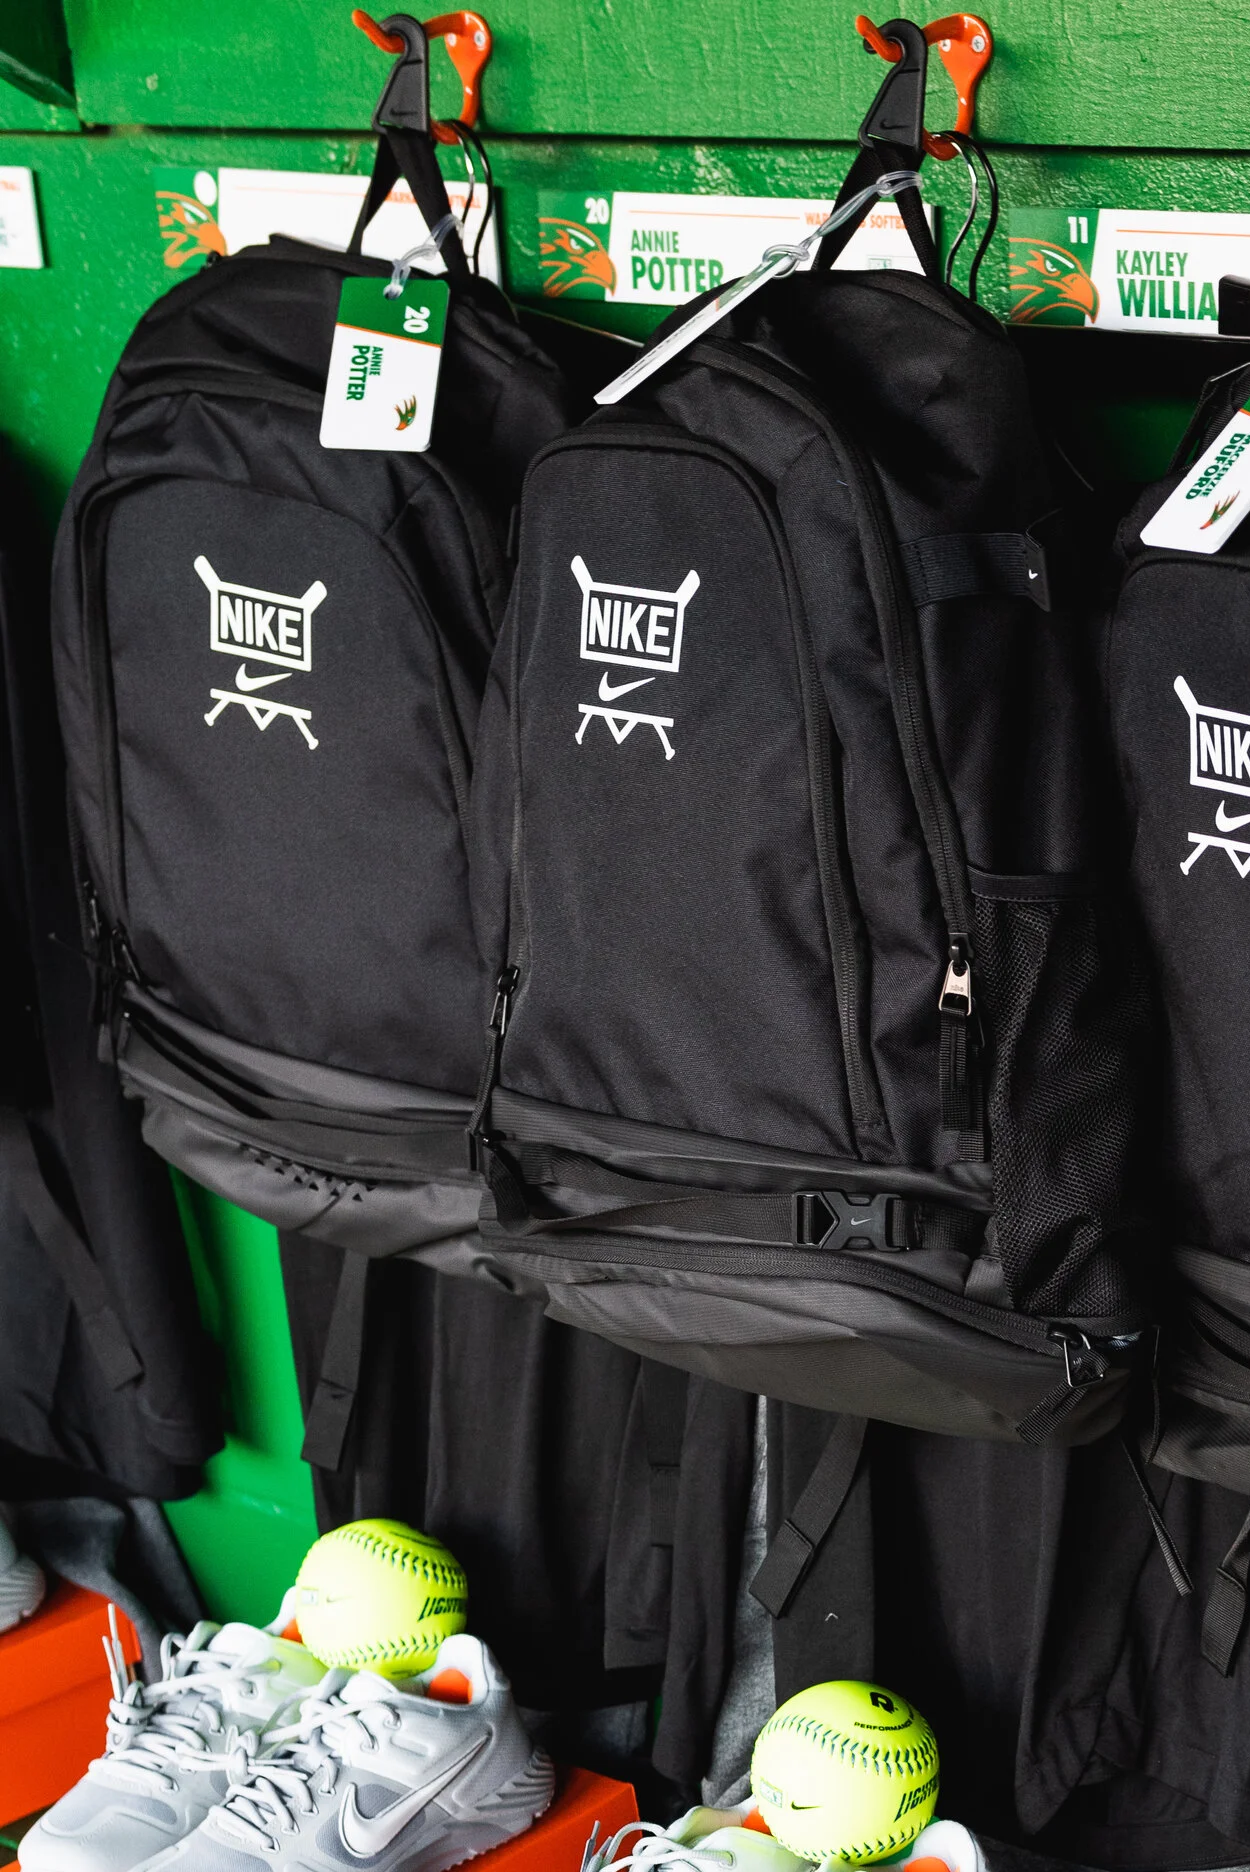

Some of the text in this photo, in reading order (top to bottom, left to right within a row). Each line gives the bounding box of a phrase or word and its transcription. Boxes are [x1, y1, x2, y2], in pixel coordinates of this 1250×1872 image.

[584, 197, 610, 225] 20
[631, 229, 680, 254] ANNIE
[1067, 216, 1089, 244] 11
[630, 255, 724, 294] POTTER
[1116, 250, 1188, 277] KAYLEY
[1116, 278, 1219, 321] WILLIA
[402, 305, 431, 334] 20
[345, 345, 372, 402] POTTER
[368, 346, 384, 377] ANNIE
[1185, 432, 1247, 500] DUFORD
[219, 594, 302, 657] NIKE
[588, 597, 675, 657] NIKE
